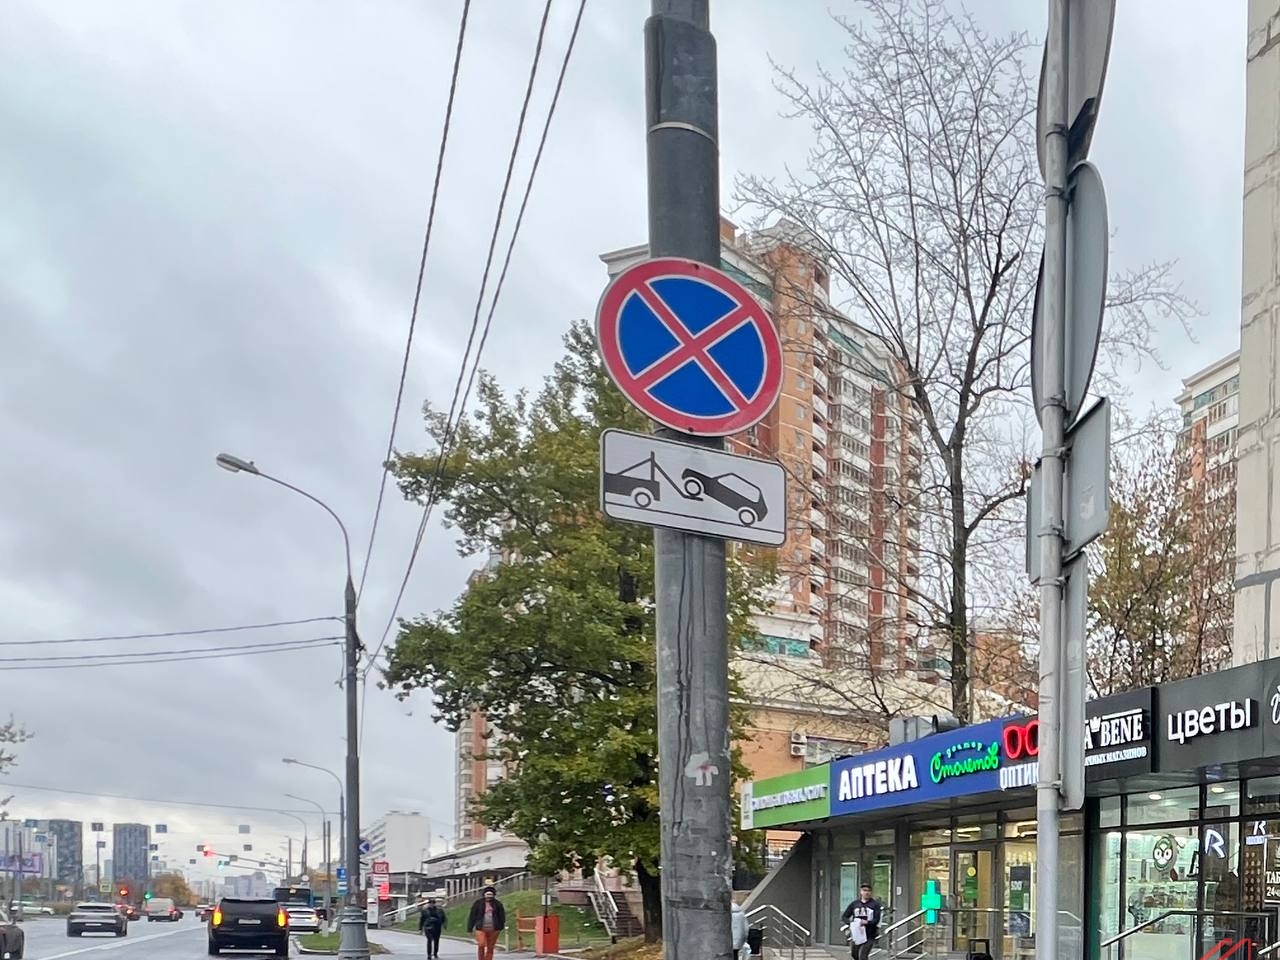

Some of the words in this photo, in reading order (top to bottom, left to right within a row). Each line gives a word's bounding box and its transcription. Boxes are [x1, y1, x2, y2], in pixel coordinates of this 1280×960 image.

[1100, 713, 1144, 747] BENE
[1168, 698, 1251, 744] цветы
[838, 754, 919, 802] АПТЕКА
[930, 741, 999, 784] Столетов
[1000, 762, 1039, 790] ОПТИК
[1205, 828, 1226, 859] R
